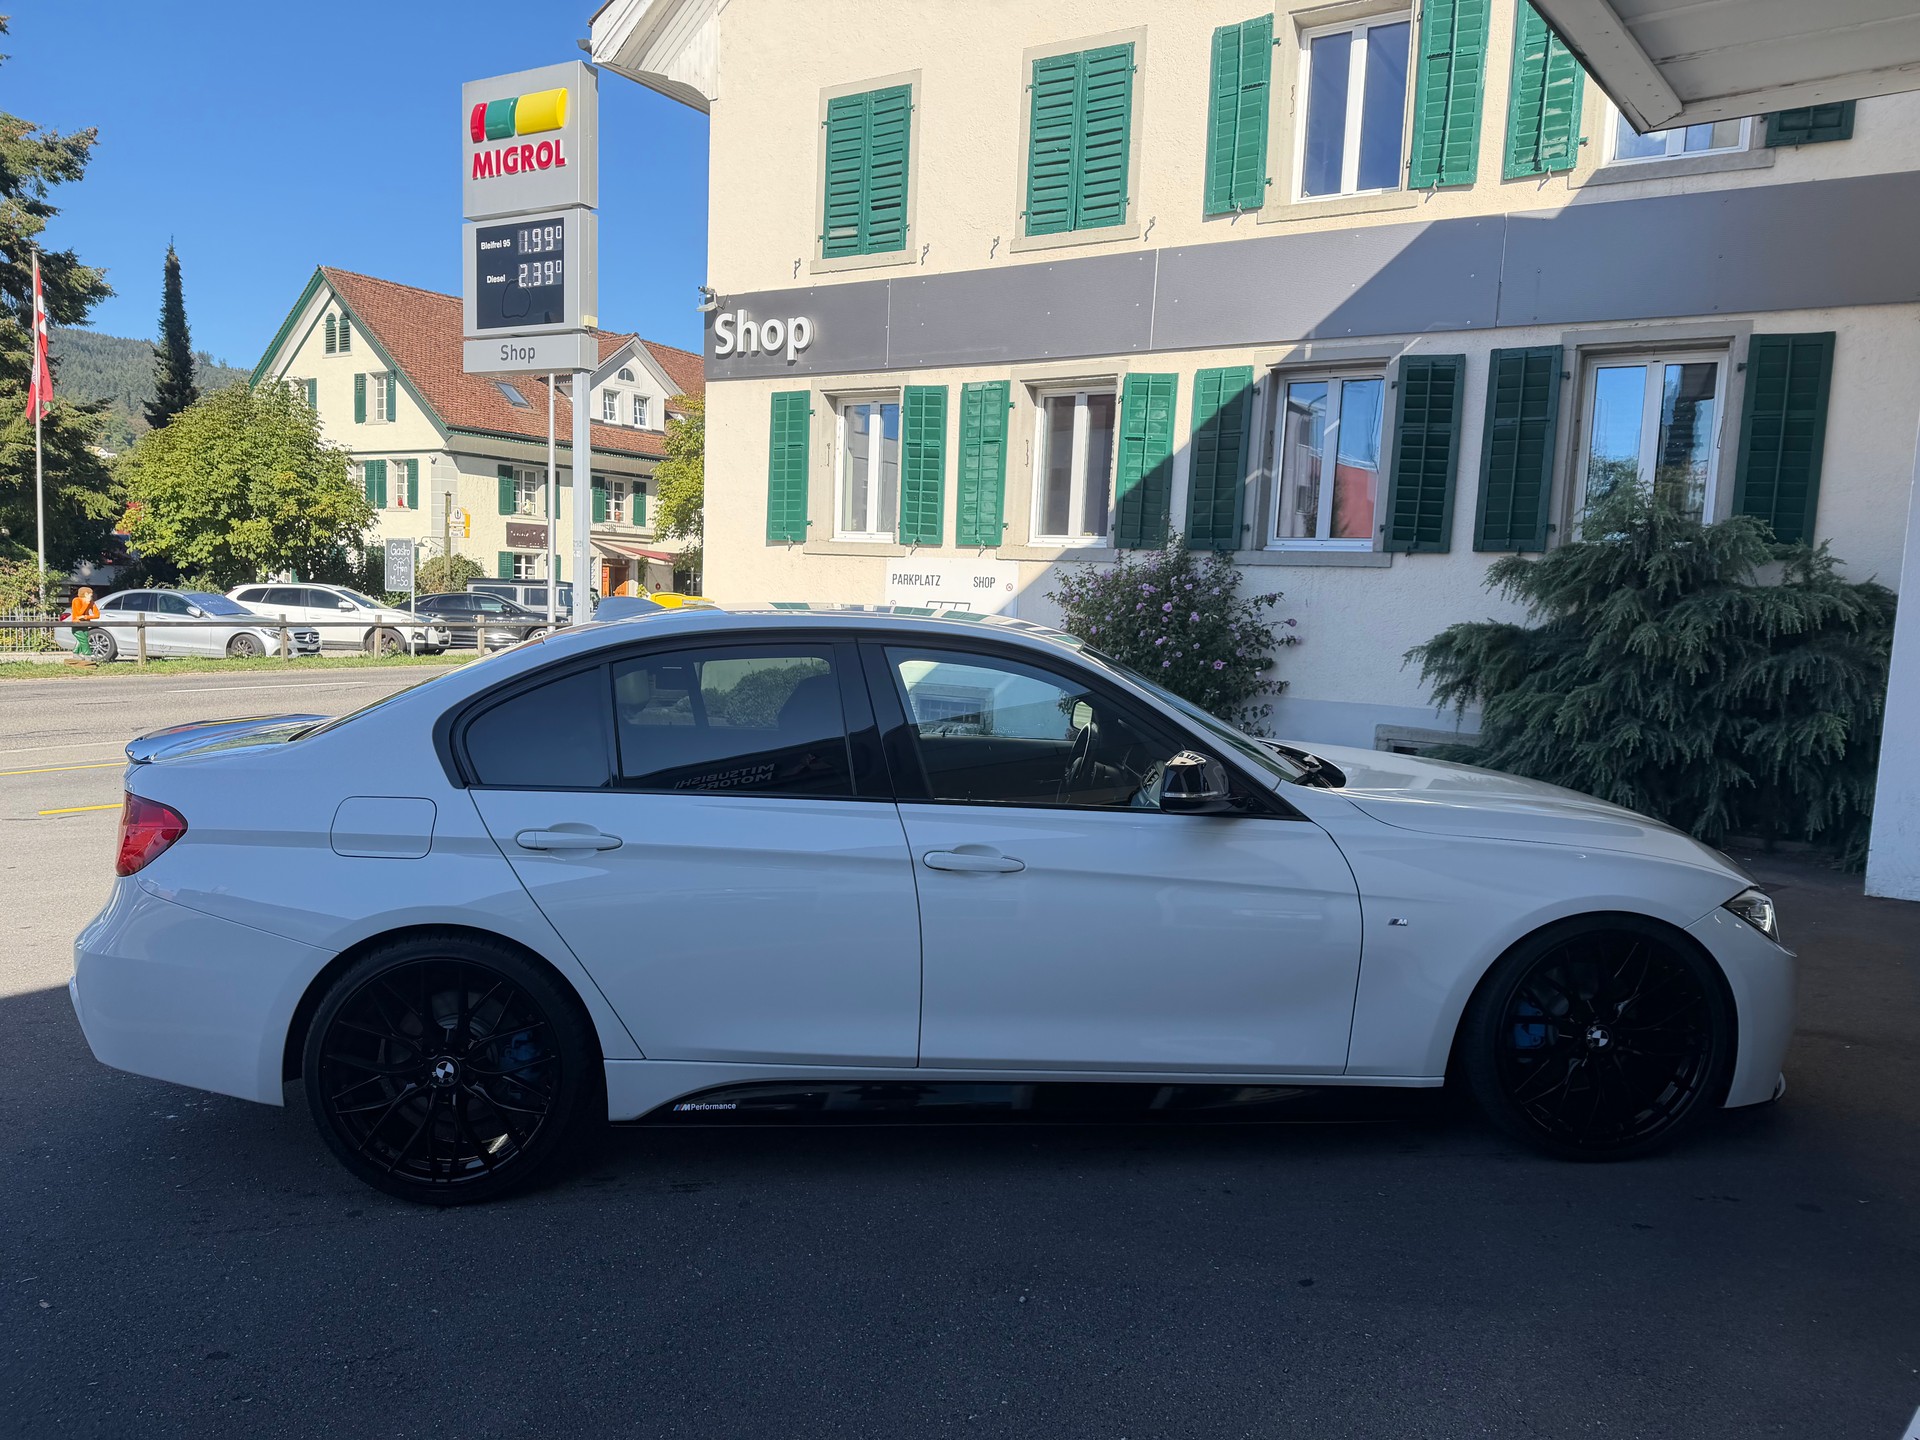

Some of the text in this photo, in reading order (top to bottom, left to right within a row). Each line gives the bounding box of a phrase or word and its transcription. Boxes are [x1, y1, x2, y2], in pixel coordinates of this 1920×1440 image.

[472, 139, 567, 180] MIGROL
[480, 240, 502, 250] Bleifrei
[502, 239, 511, 248] 95
[486, 274, 506, 284] Diesel
[714, 309, 814, 363] Shop
[500, 343, 536, 364] Shop
[891, 573, 996, 589] PARKPLATZ SHOP
[690, 1102, 737, 1111] Performance
